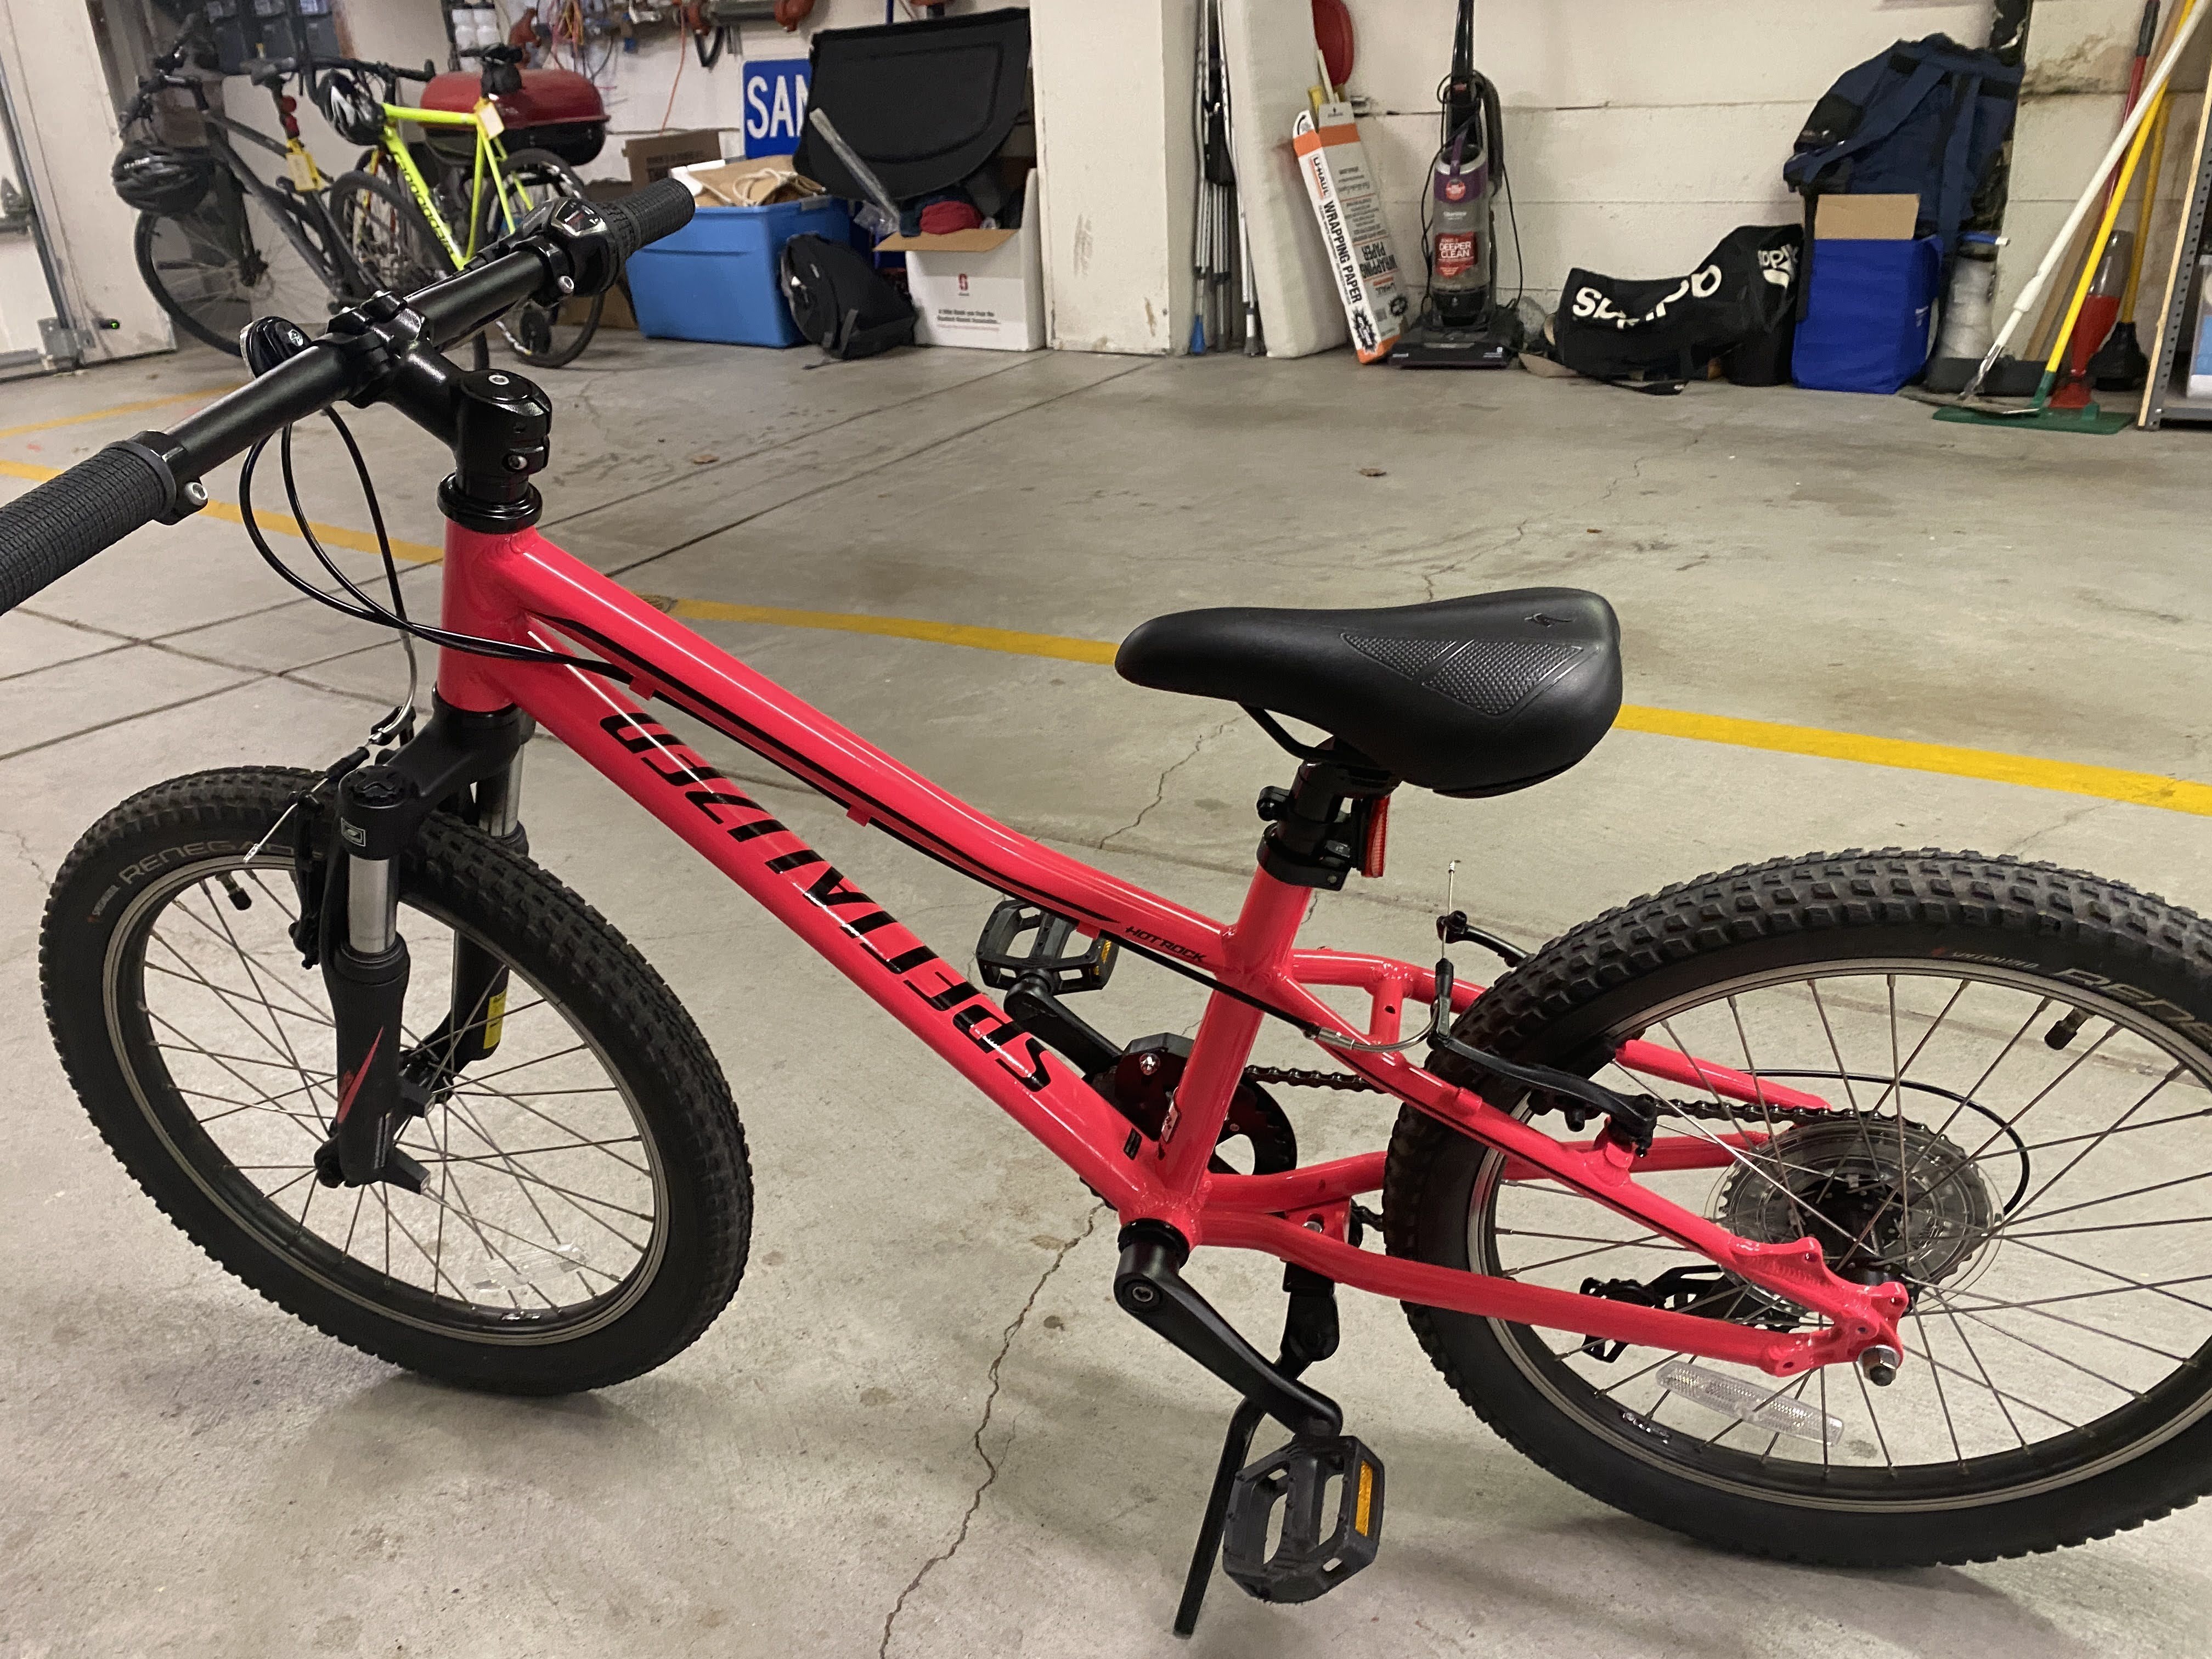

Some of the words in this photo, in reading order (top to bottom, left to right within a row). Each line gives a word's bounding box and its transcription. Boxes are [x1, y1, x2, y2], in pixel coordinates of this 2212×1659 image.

[1313, 156, 1329, 195] U-HAUL
[1323, 200, 1351, 264] WRAPPING
[1342, 264, 1363, 303] PAPER
[1439, 241, 1471, 252] DEEPER
[1441, 249, 1470, 258] CLEAN
[600, 713, 1052, 1092] SPECIALIZED
